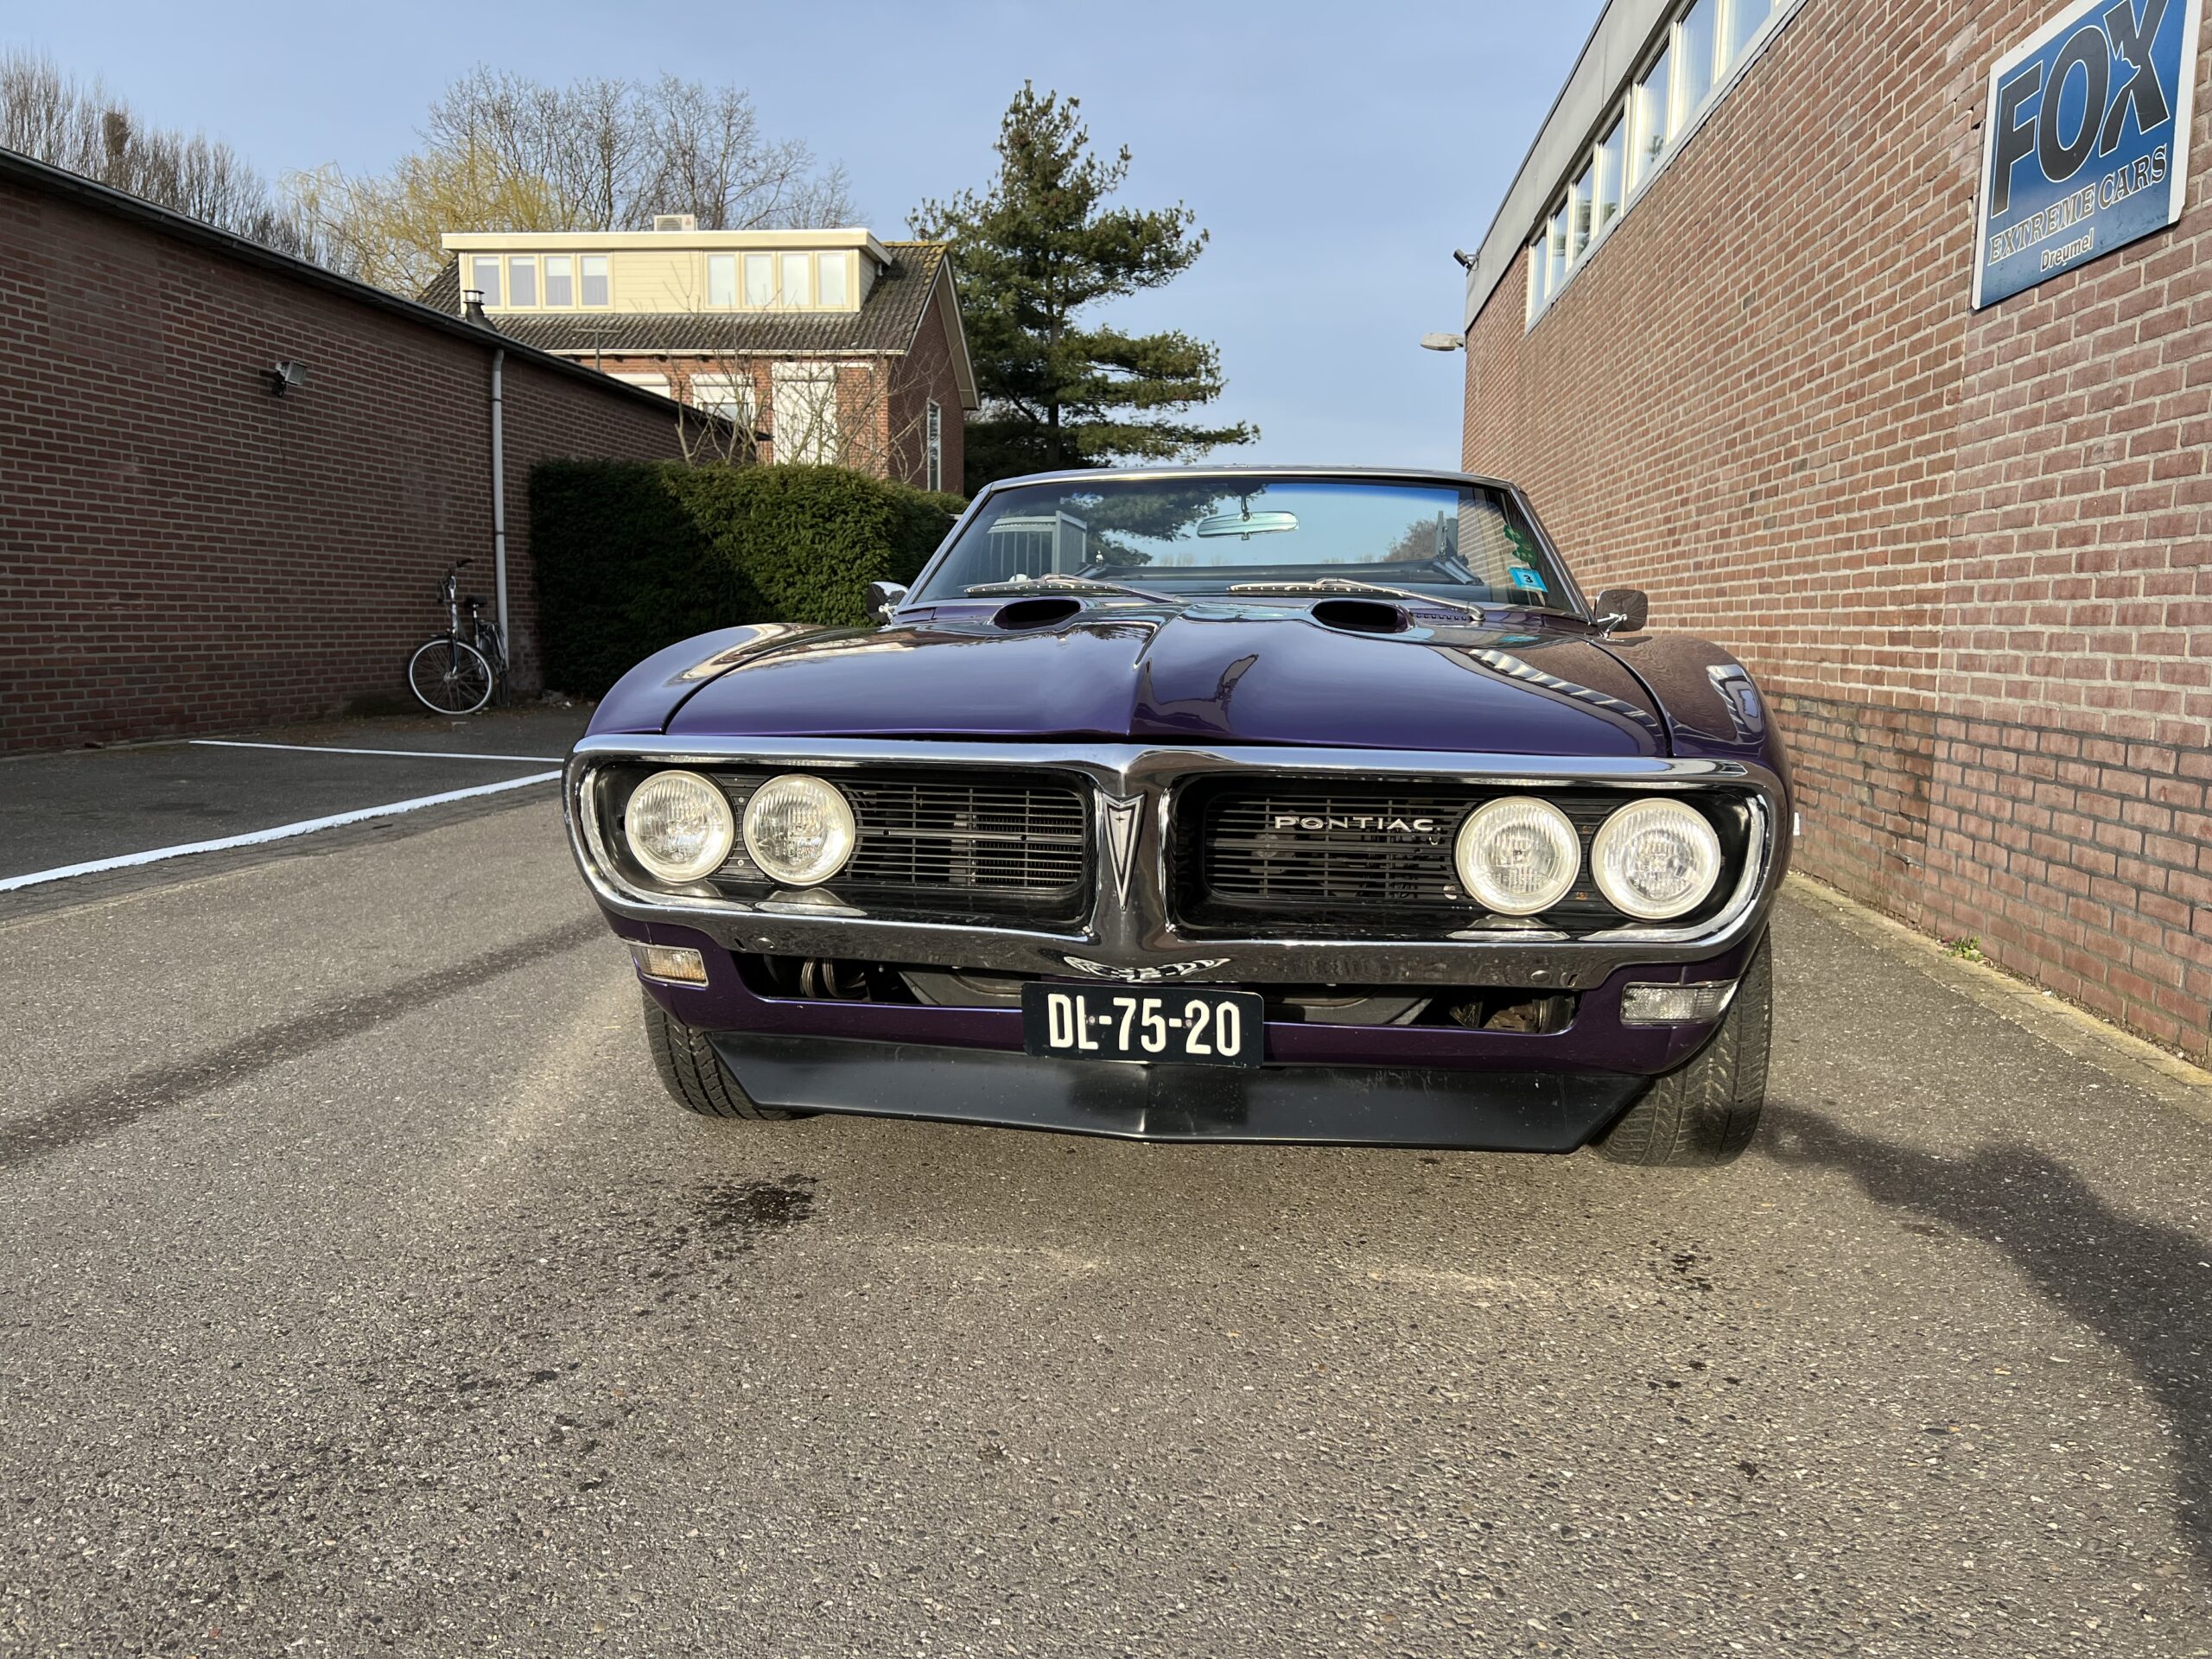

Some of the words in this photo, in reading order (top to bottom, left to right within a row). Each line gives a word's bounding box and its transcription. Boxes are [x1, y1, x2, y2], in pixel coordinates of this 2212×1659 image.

[1991, 0, 2171, 219] FOX
[1987, 182, 2096, 266] EXTREME
[2097, 143, 2167, 209] CARS
[2040, 226, 2094, 272] Dreumel
[1274, 815, 1434, 833] PONTIAC
[1047, 993, 1242, 1057] DL-75-20
